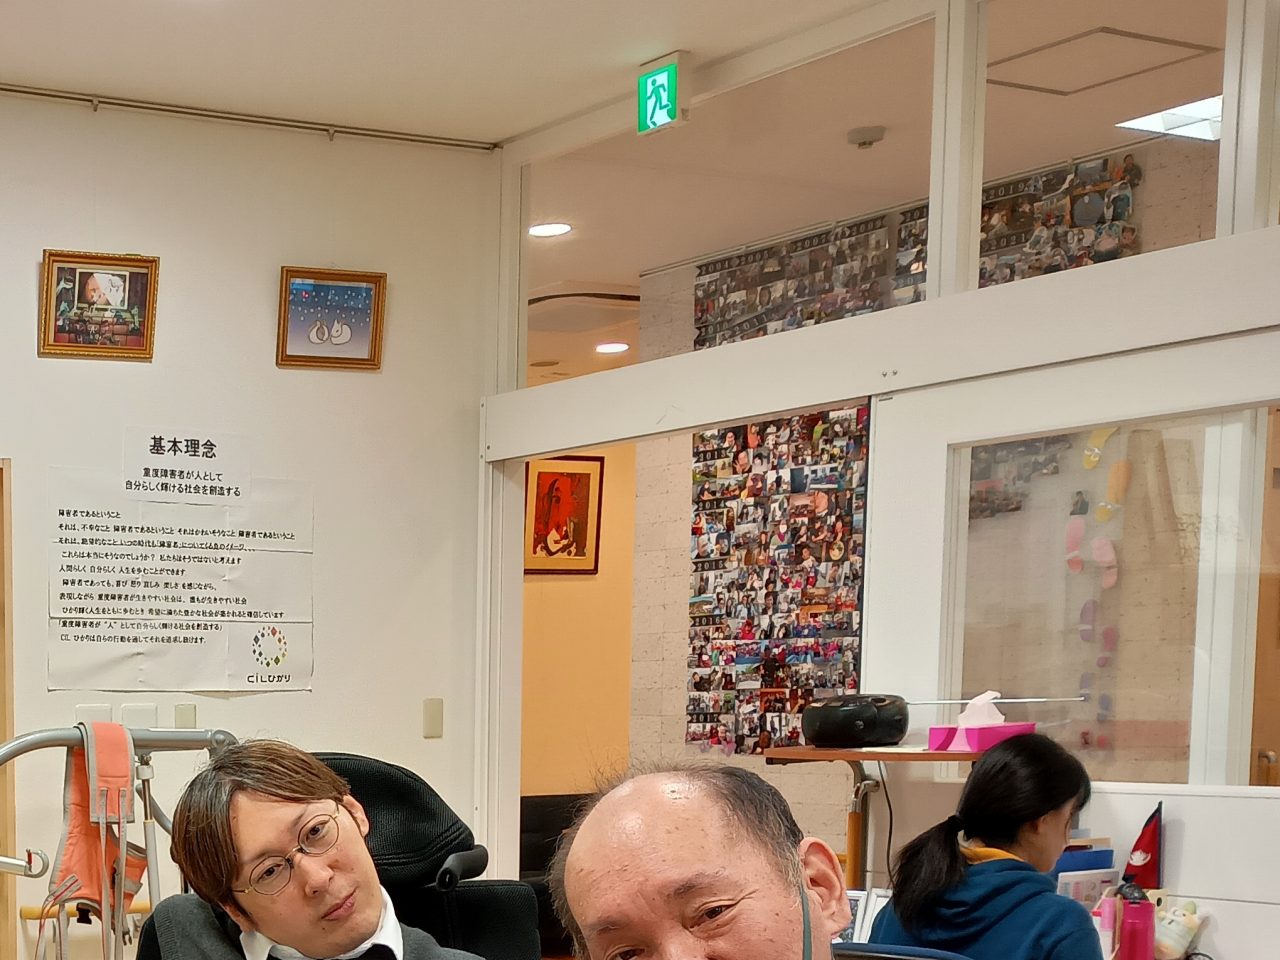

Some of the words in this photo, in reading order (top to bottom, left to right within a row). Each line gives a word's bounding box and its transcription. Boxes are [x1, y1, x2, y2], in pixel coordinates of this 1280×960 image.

[149, 435, 218, 460] 基本理念
[143, 466, 224, 483] 重度障害者が人として
[125, 479, 241, 498] 自分らしく輝ける社会を創造する
[58, 508, 121, 519] 障害者であるということ
[58, 564, 87, 574] 人間らしく
[90, 565, 116, 574] 自分らしく
